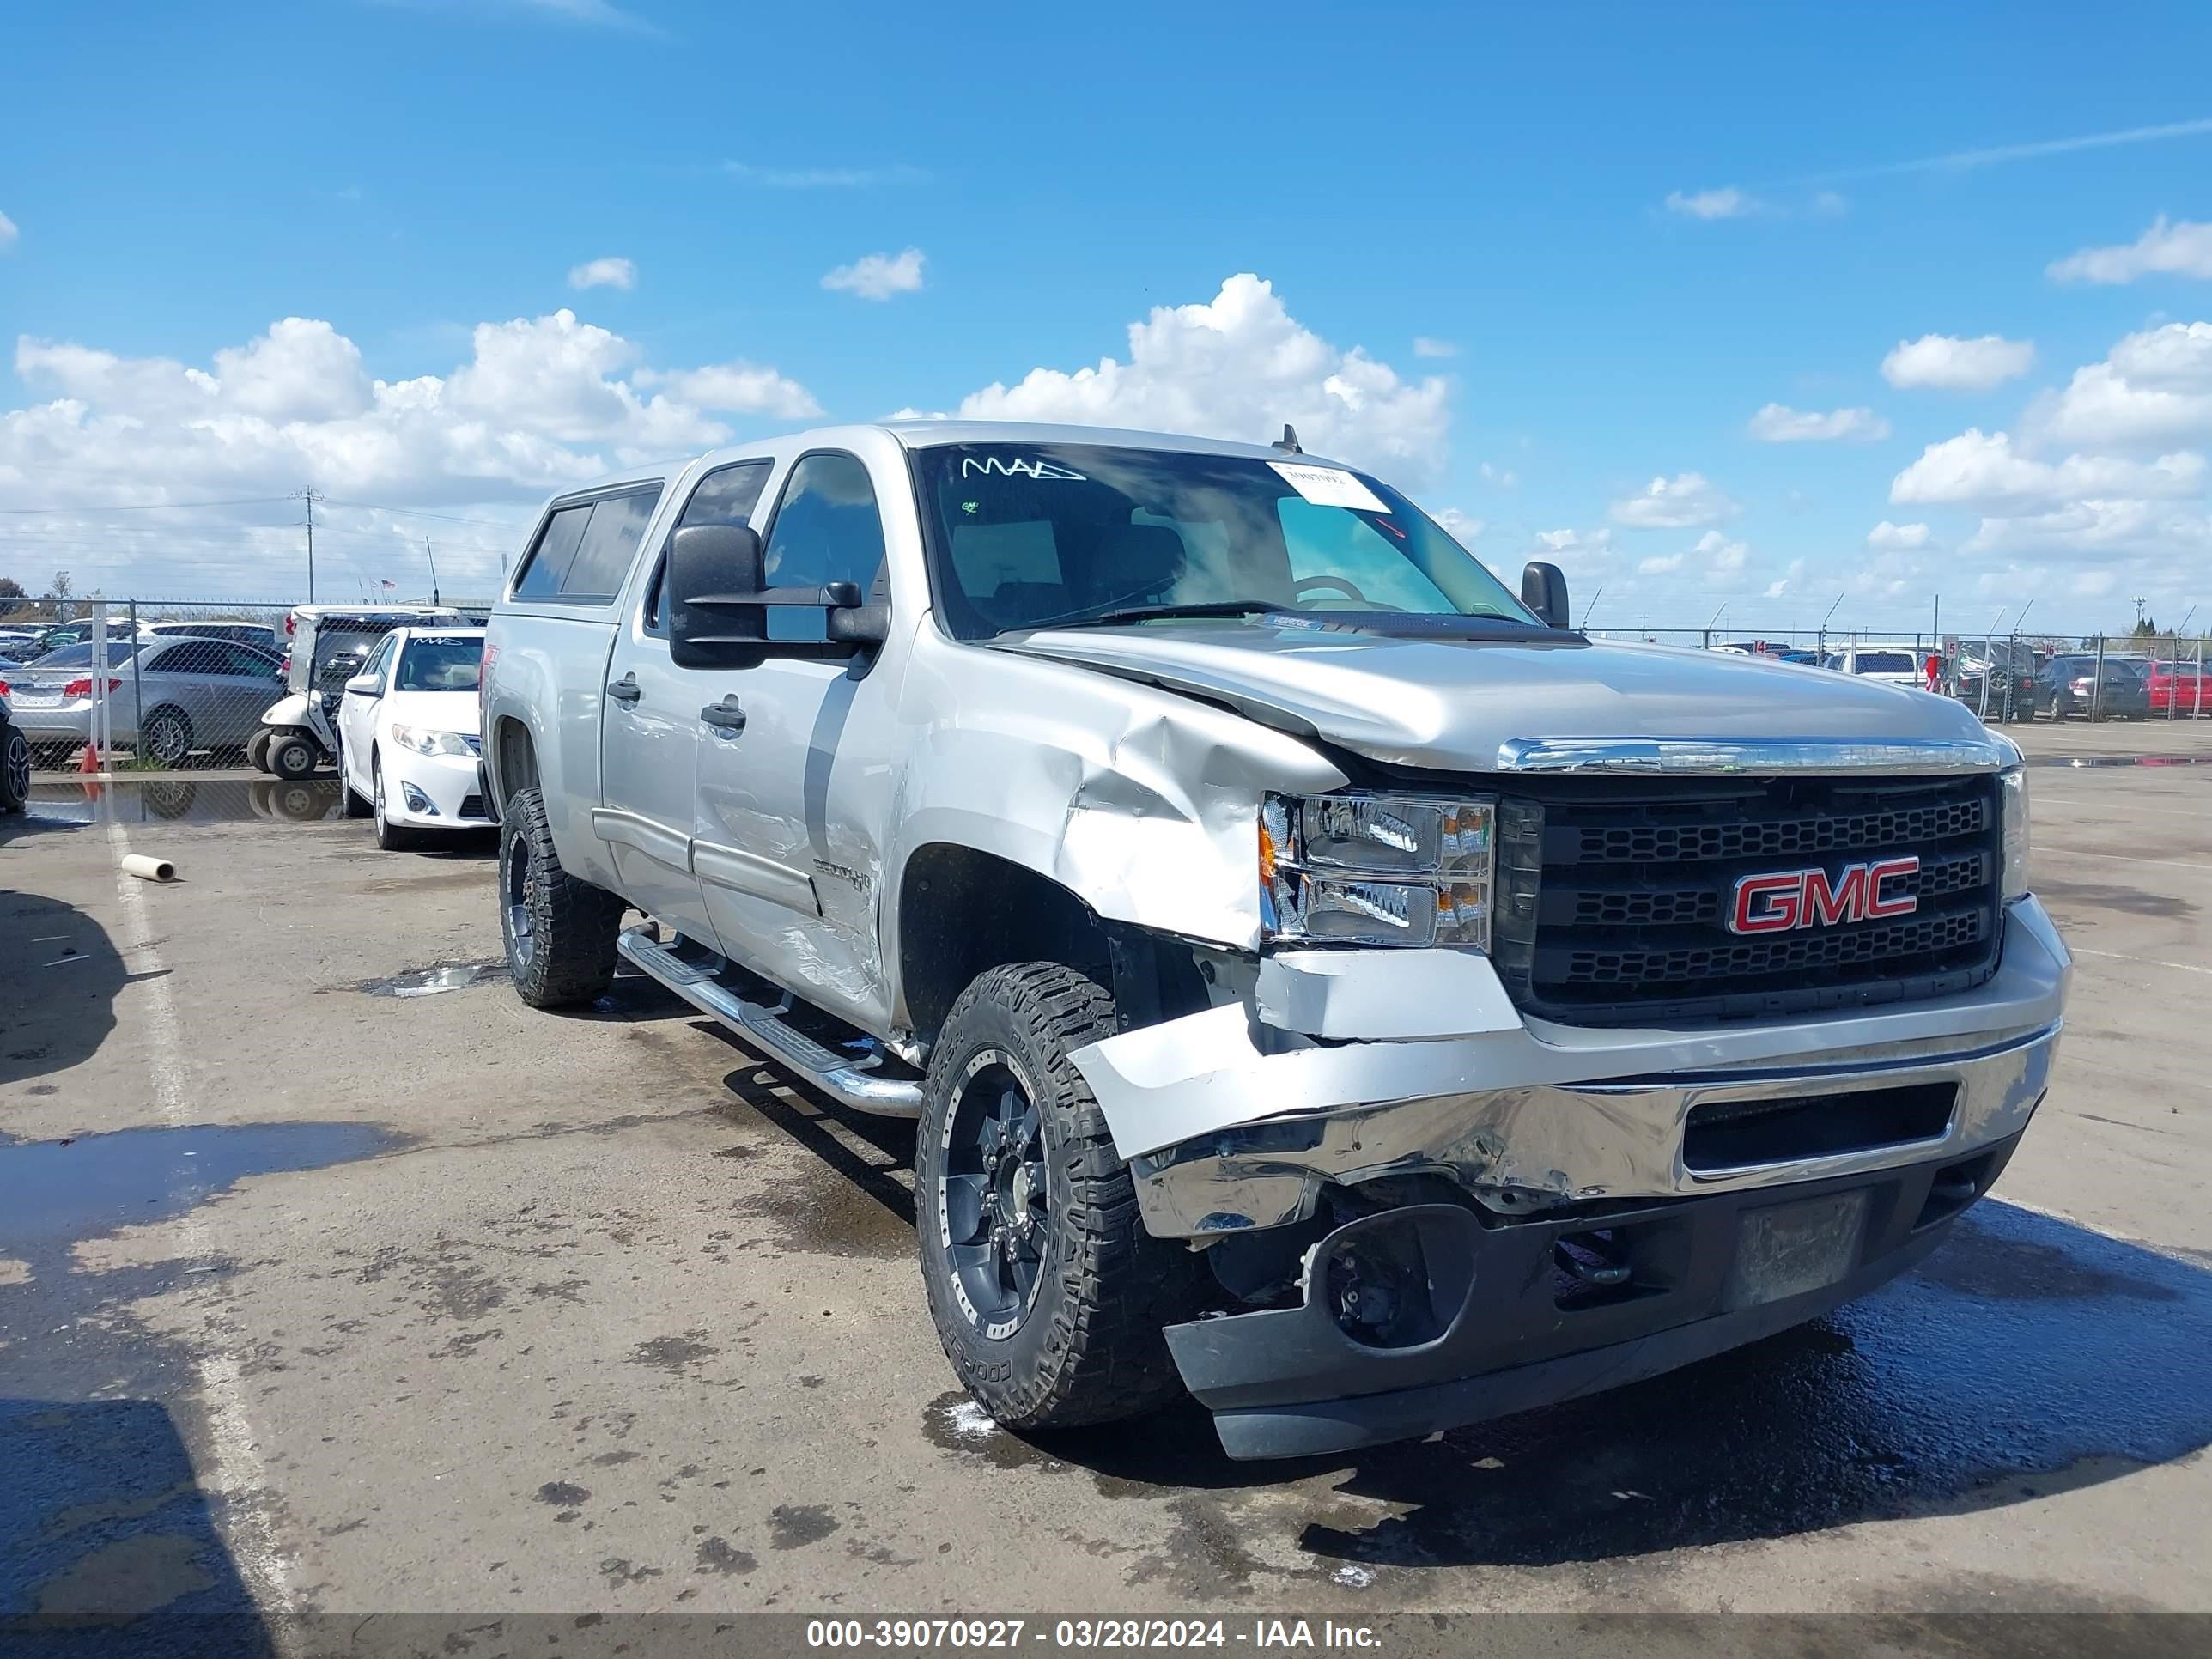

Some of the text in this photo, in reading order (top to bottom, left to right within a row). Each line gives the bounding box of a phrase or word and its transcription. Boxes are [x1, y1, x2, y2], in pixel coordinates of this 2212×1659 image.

[1753, 640, 1765, 654] 14
[1945, 642, 1956, 655] 15
[2045, 645, 2055, 656] 16
[1728, 855, 1920, 936] GMC
[945, 1320, 1013, 1383] COOPER
